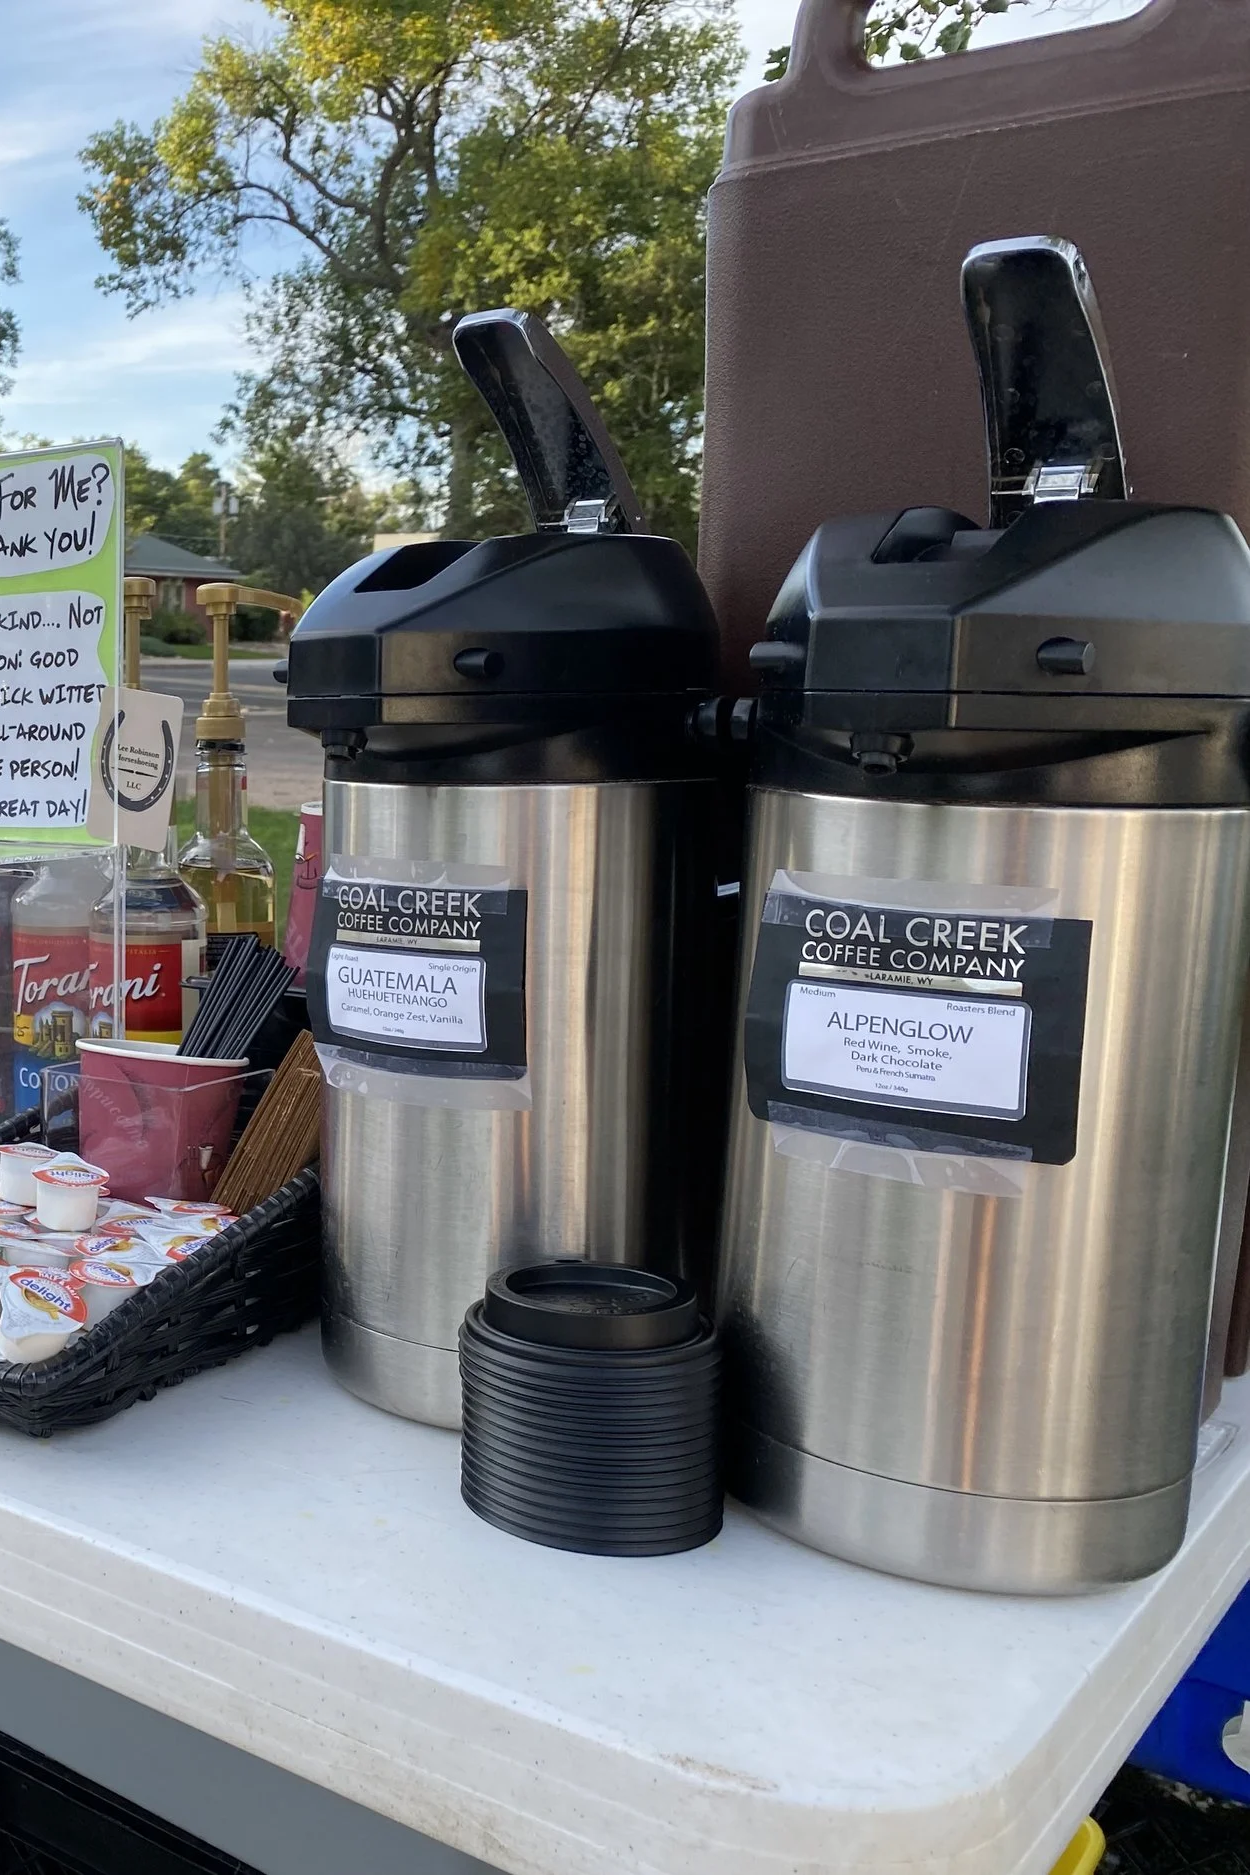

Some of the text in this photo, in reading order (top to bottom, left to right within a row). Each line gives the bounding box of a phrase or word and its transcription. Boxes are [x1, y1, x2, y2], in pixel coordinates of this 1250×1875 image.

[43, 511, 96, 560] YOU!
[69, 596, 104, 630] NOT
[30, 648, 78, 669] GOOD
[117, 744, 160, 758] Lee Robinson
[10, 747, 80, 781] PERSON!
[126, 781, 141, 790] LLC
[47, 788, 87, 823] DAY!
[338, 885, 482, 918] COAL CREEK
[338, 911, 481, 938] COFFEE COMPANY
[805, 908, 1029, 955] COAL CREEK
[407, 938, 418, 946] WY
[428, 963, 477, 974] Single Origin
[801, 940, 1025, 979] COFFEE COMPANY
[338, 966, 458, 995] GUATEMALA
[799, 986, 836, 998] Medium
[917, 976, 934, 986] WY
[348, 988, 448, 1008] HUEHUETENANGO
[946, 1002, 1016, 1017] Roasters Blend
[341, 1003, 464, 1025] Caramel, Orange Zest, Vanilla
[827, 1011, 974, 1044] ALPENGLOW
[843, 1037, 953, 1061] Red Wine, Smoke,
[851, 1050, 943, 1071] Dark Chocolate
[856, 1065, 873, 1074] Peru
[879, 1067, 904, 1077] French
[904, 1071, 936, 1081] Sumatra
[20, 1278, 71, 1312] delight
